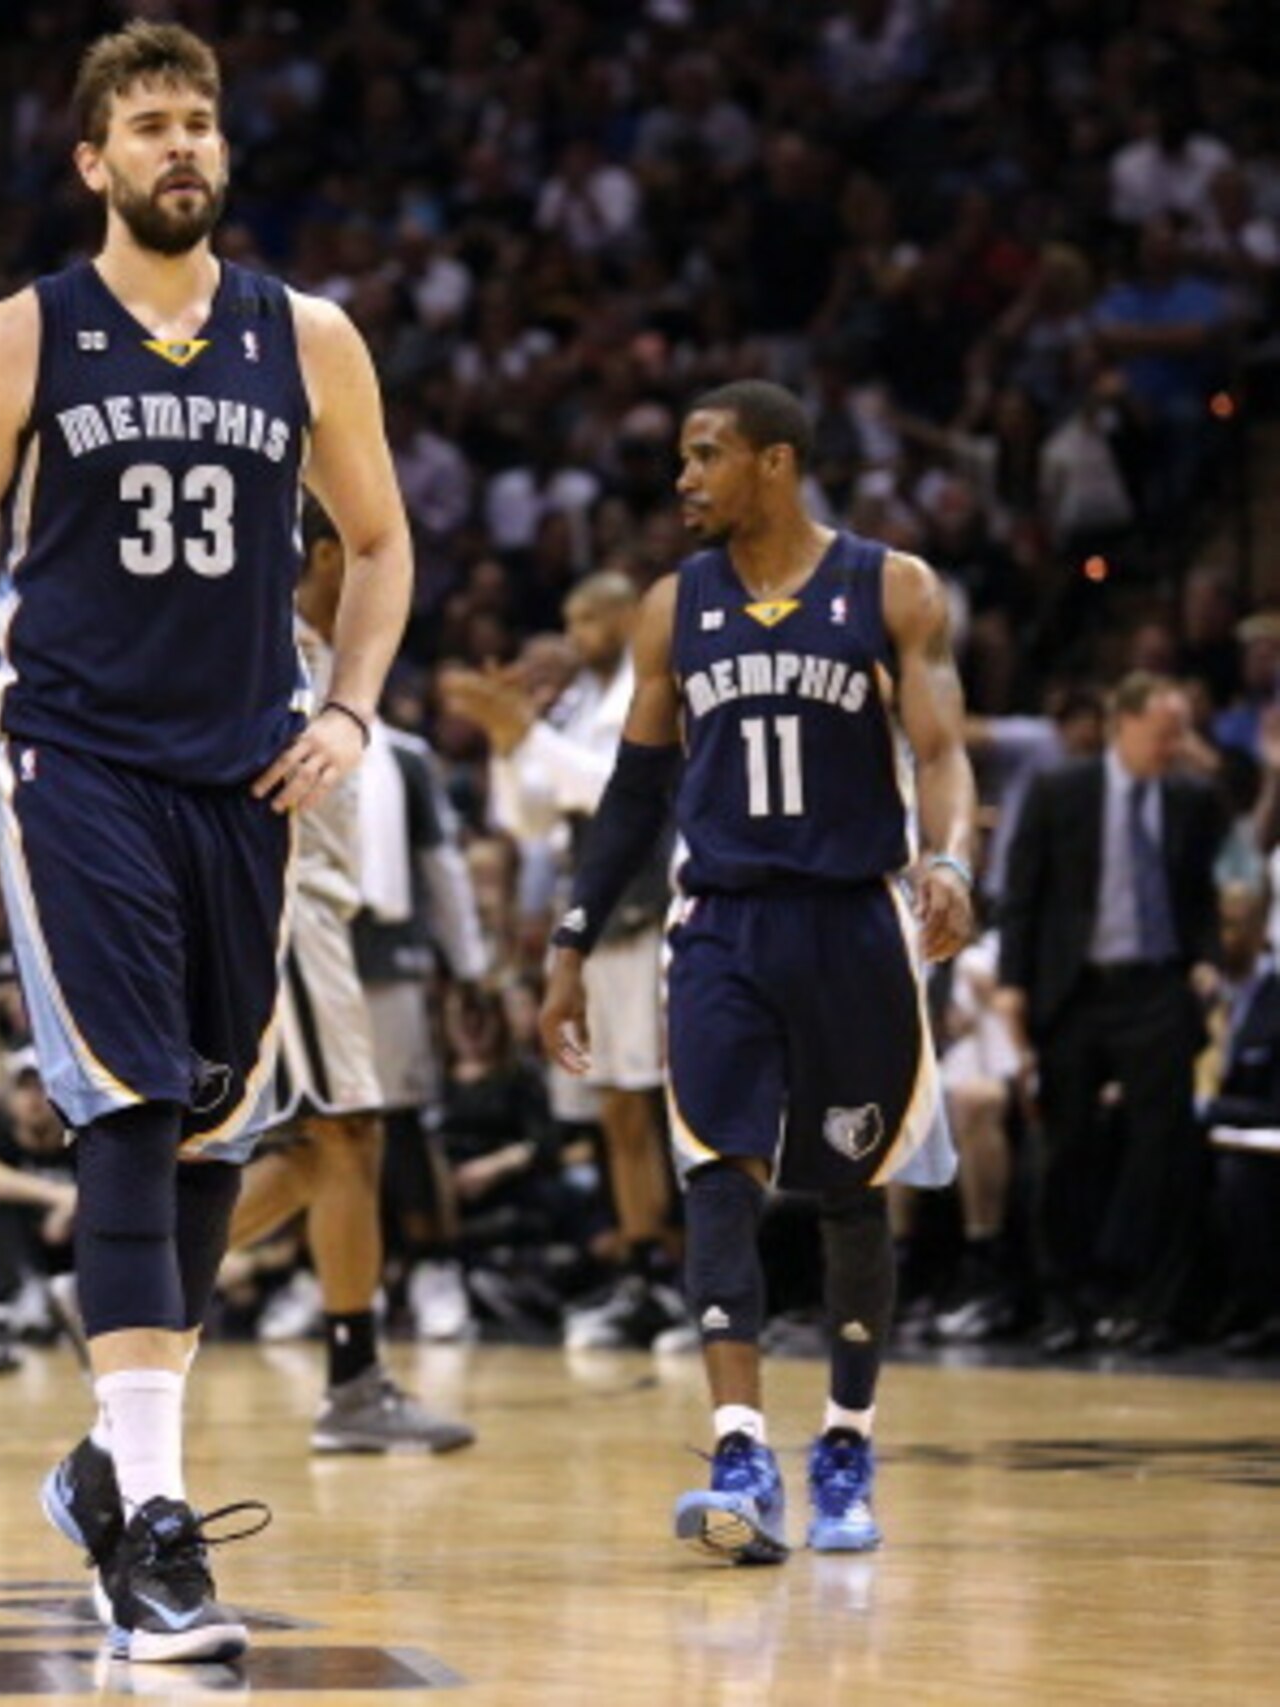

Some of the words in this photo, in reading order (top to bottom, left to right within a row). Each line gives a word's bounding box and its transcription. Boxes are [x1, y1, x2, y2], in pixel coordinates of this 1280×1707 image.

[56, 393, 291, 463] MEMPHIS
[120, 463, 235, 578] 33
[685, 653, 869, 718] MEMPHIS
[740, 715, 804, 817] 11
